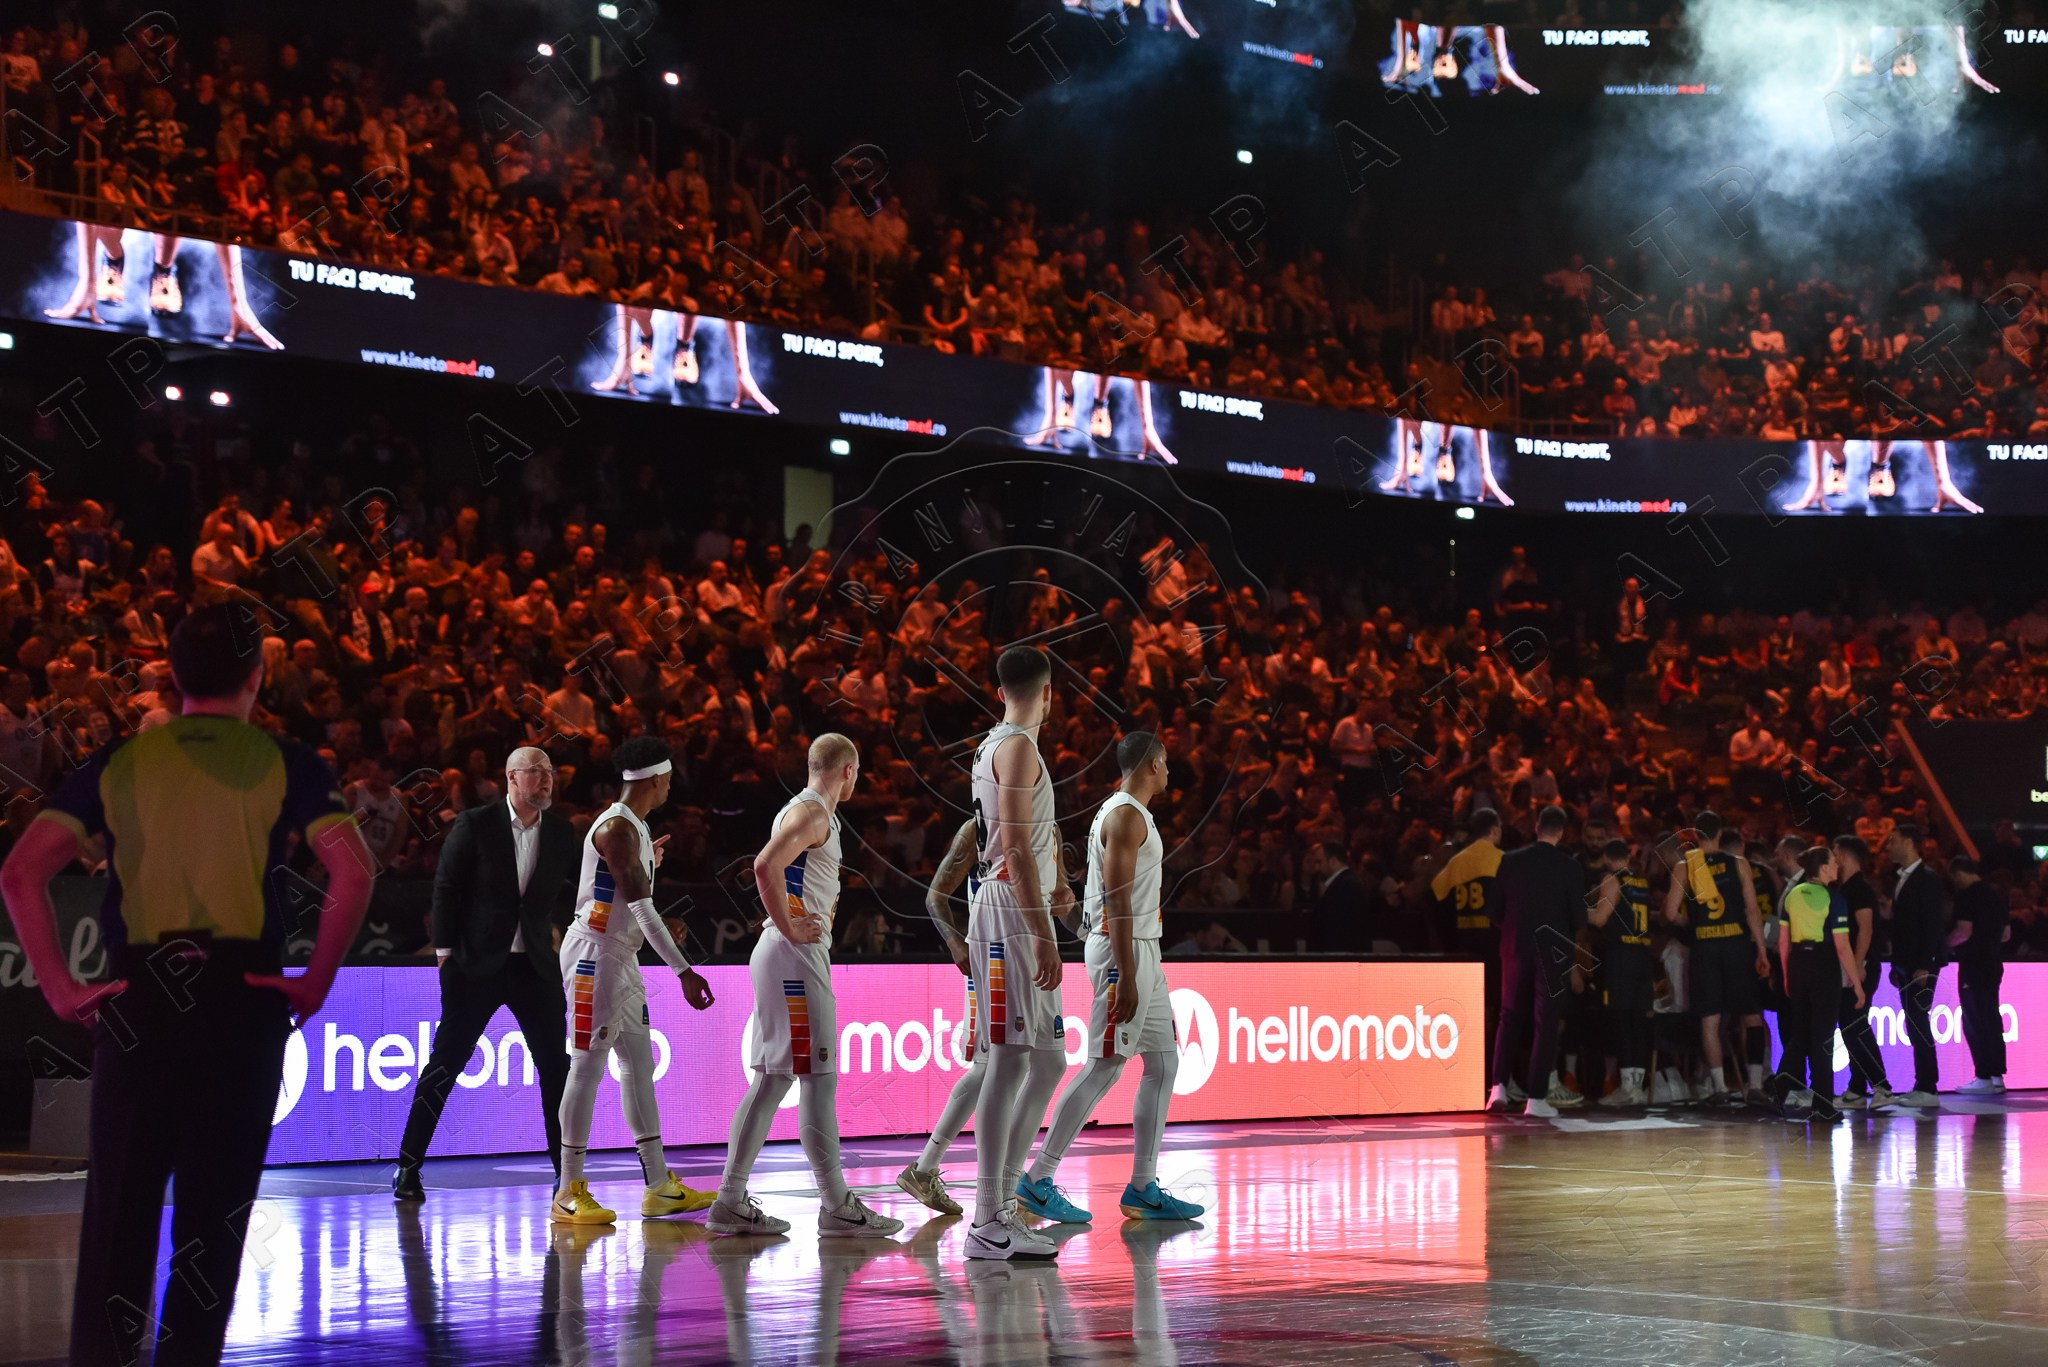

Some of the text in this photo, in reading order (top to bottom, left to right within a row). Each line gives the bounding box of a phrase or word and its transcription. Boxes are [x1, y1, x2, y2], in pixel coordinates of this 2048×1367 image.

[1542, 30, 1650, 47] TU FACI SPORT,
[2003, 29, 2048, 44] TU FA
[288, 259, 314, 281] TU
[782, 333, 803, 353] TU
[1515, 437, 1533, 455] TU
[1986, 444, 2010, 460] TU
[1228, 1005, 1460, 1064] hellomoto
